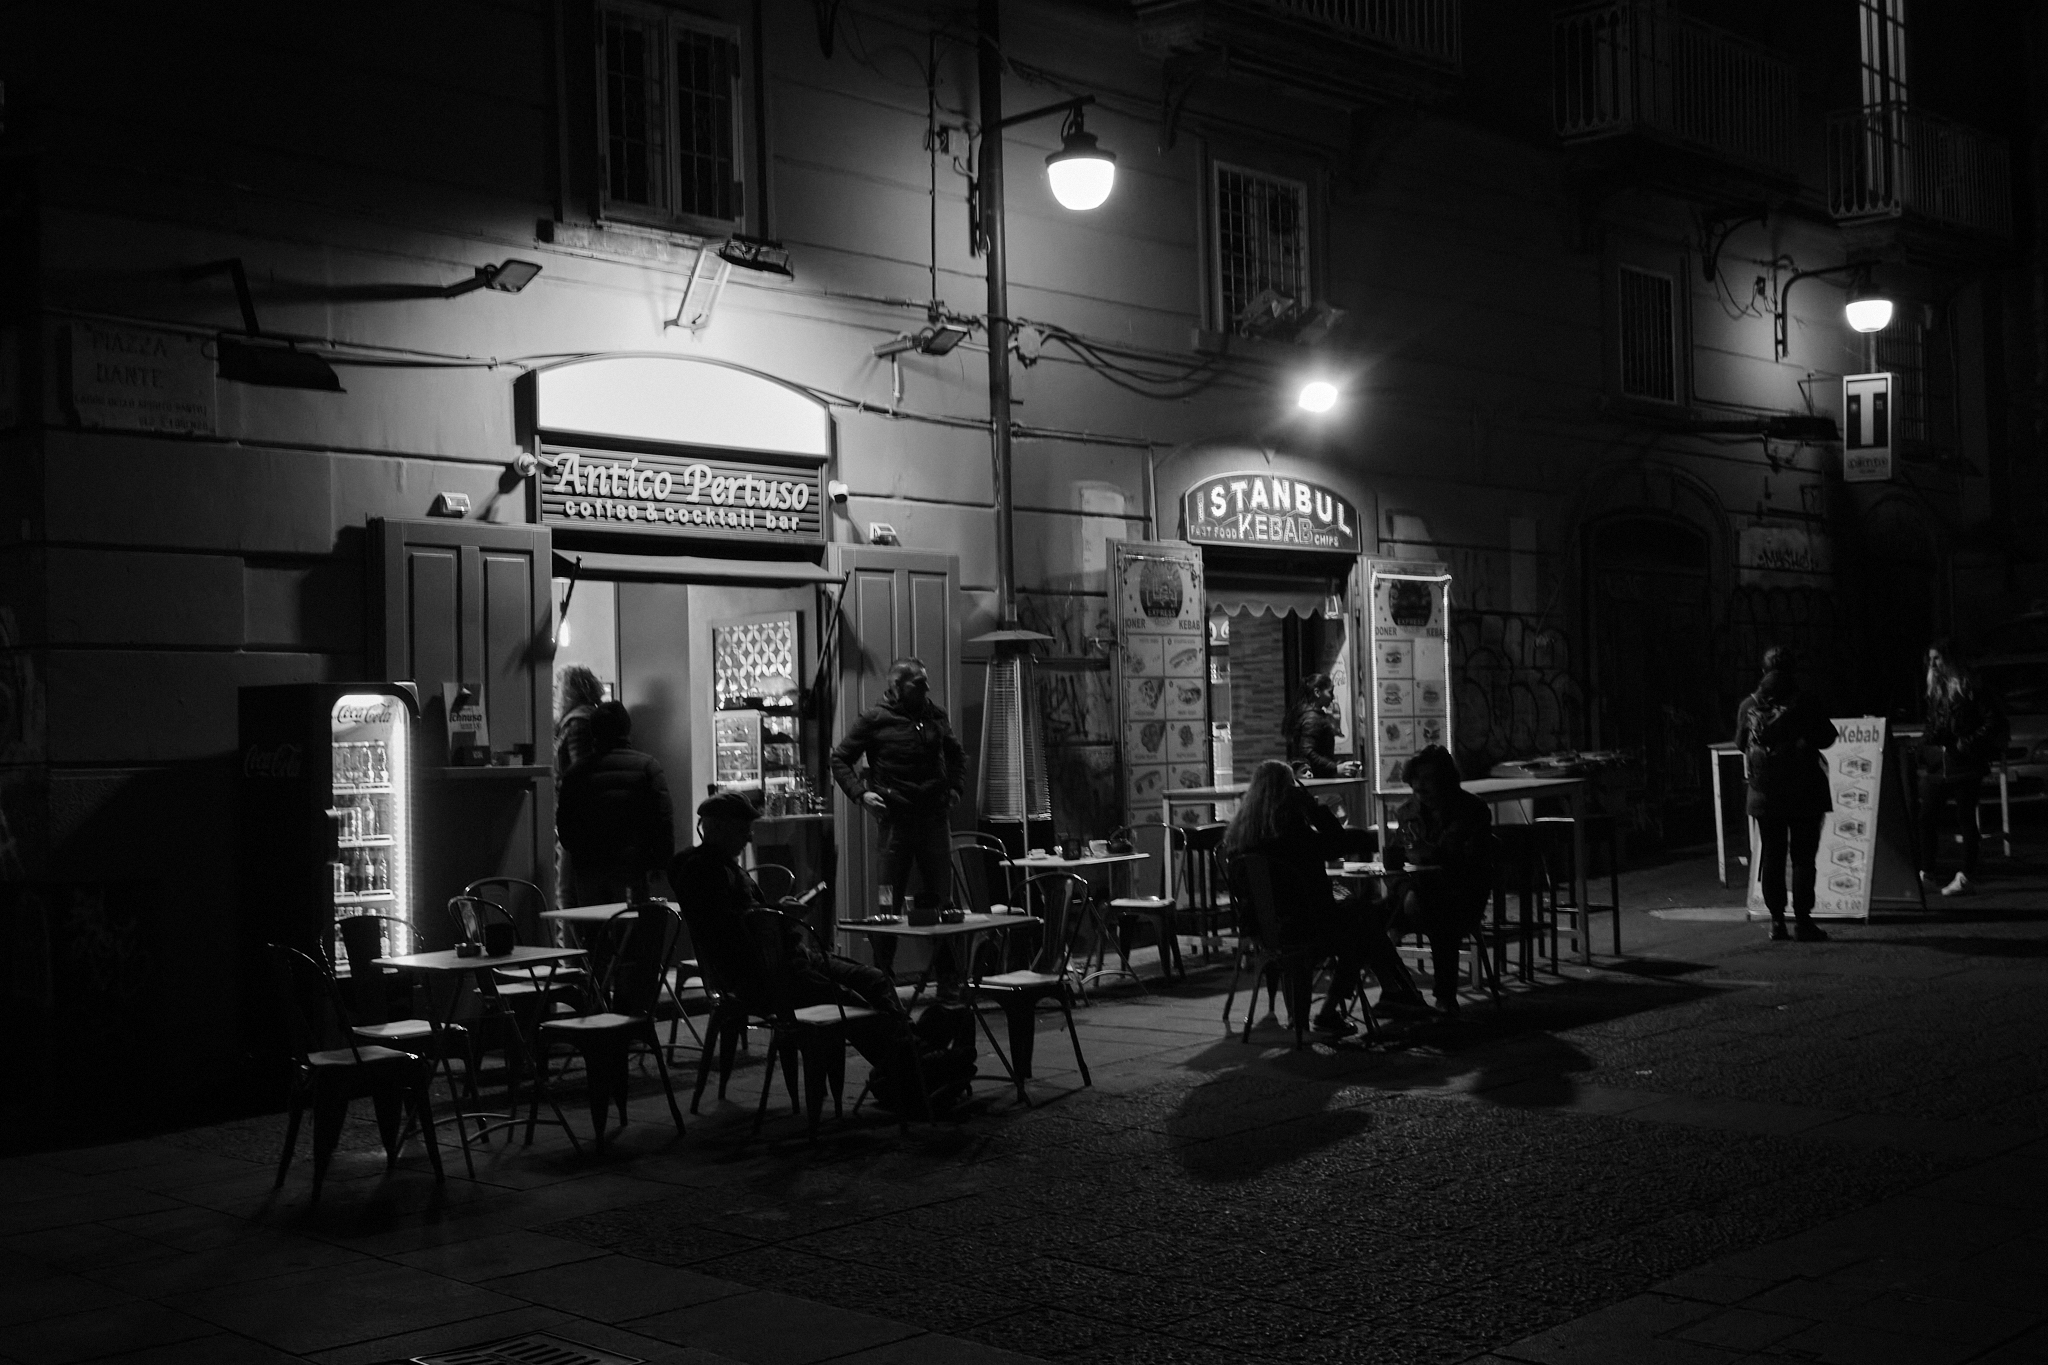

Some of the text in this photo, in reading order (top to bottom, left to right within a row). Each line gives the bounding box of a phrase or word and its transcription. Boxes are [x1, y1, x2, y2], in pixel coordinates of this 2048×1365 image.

[92, 331, 167, 358] PIAZZA
[96, 362, 164, 389] DANTE
[1847, 379, 1887, 446] T
[552, 452, 809, 511] Antico Pertuso
[565, 499, 800, 531] coffee & cocktail bar
[1197, 476, 1352, 538] ISTANBUL
[1190, 525, 1237, 539] FAST FOOD
[1238, 513, 1313, 545] KEBAB
[1314, 535, 1340, 548] CHIPS
[1148, 608, 1176, 618] EXPRESS
[1397, 618, 1426, 626] EXPRESS
[1179, 620, 1201, 630] KEBAB
[1426, 628, 1445, 637] KEBA
[1838, 725, 1880, 743] Kebab
